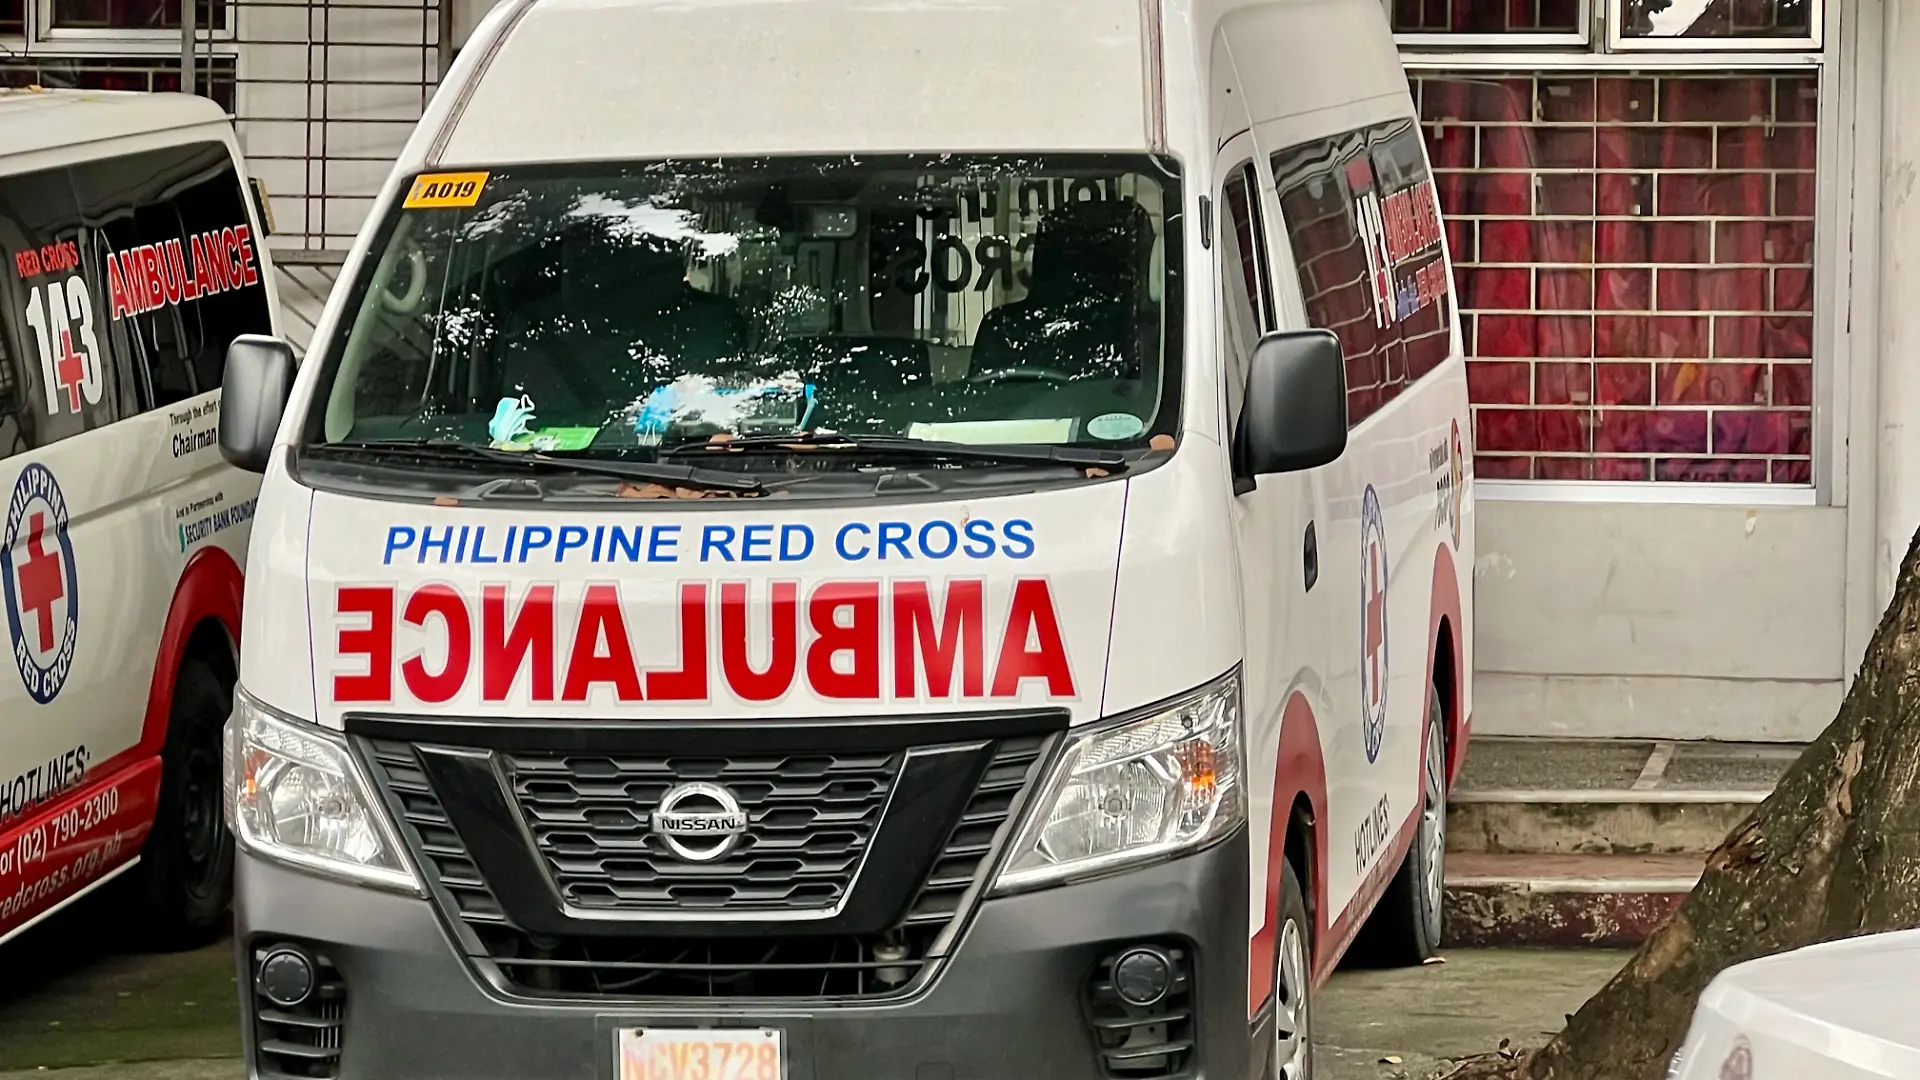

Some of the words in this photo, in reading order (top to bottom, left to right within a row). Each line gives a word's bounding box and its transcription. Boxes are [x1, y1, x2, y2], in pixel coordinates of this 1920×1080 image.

[421, 181, 477, 199] A019
[16, 250, 41, 278] RED
[41, 241, 79, 273] CROSS
[107, 224, 258, 321] AMBULANCE
[26, 276, 103, 415] 143
[173, 428, 217, 458] Chairman
[6, 468, 68, 551] PHILIPPINE
[185, 516, 212, 546] SECURITY
[382, 525, 681, 565] PHILIPPINE
[699, 524, 815, 562] RED
[835, 519, 1036, 561] CROSS
[17, 635, 40, 693] RED
[43, 616, 75, 697] CROSS
[0, 848, 15, 875] or
[17, 825, 47, 875] (02)
[52, 786, 118, 848] 790-2300
[661, 818, 736, 831] NISSAN
